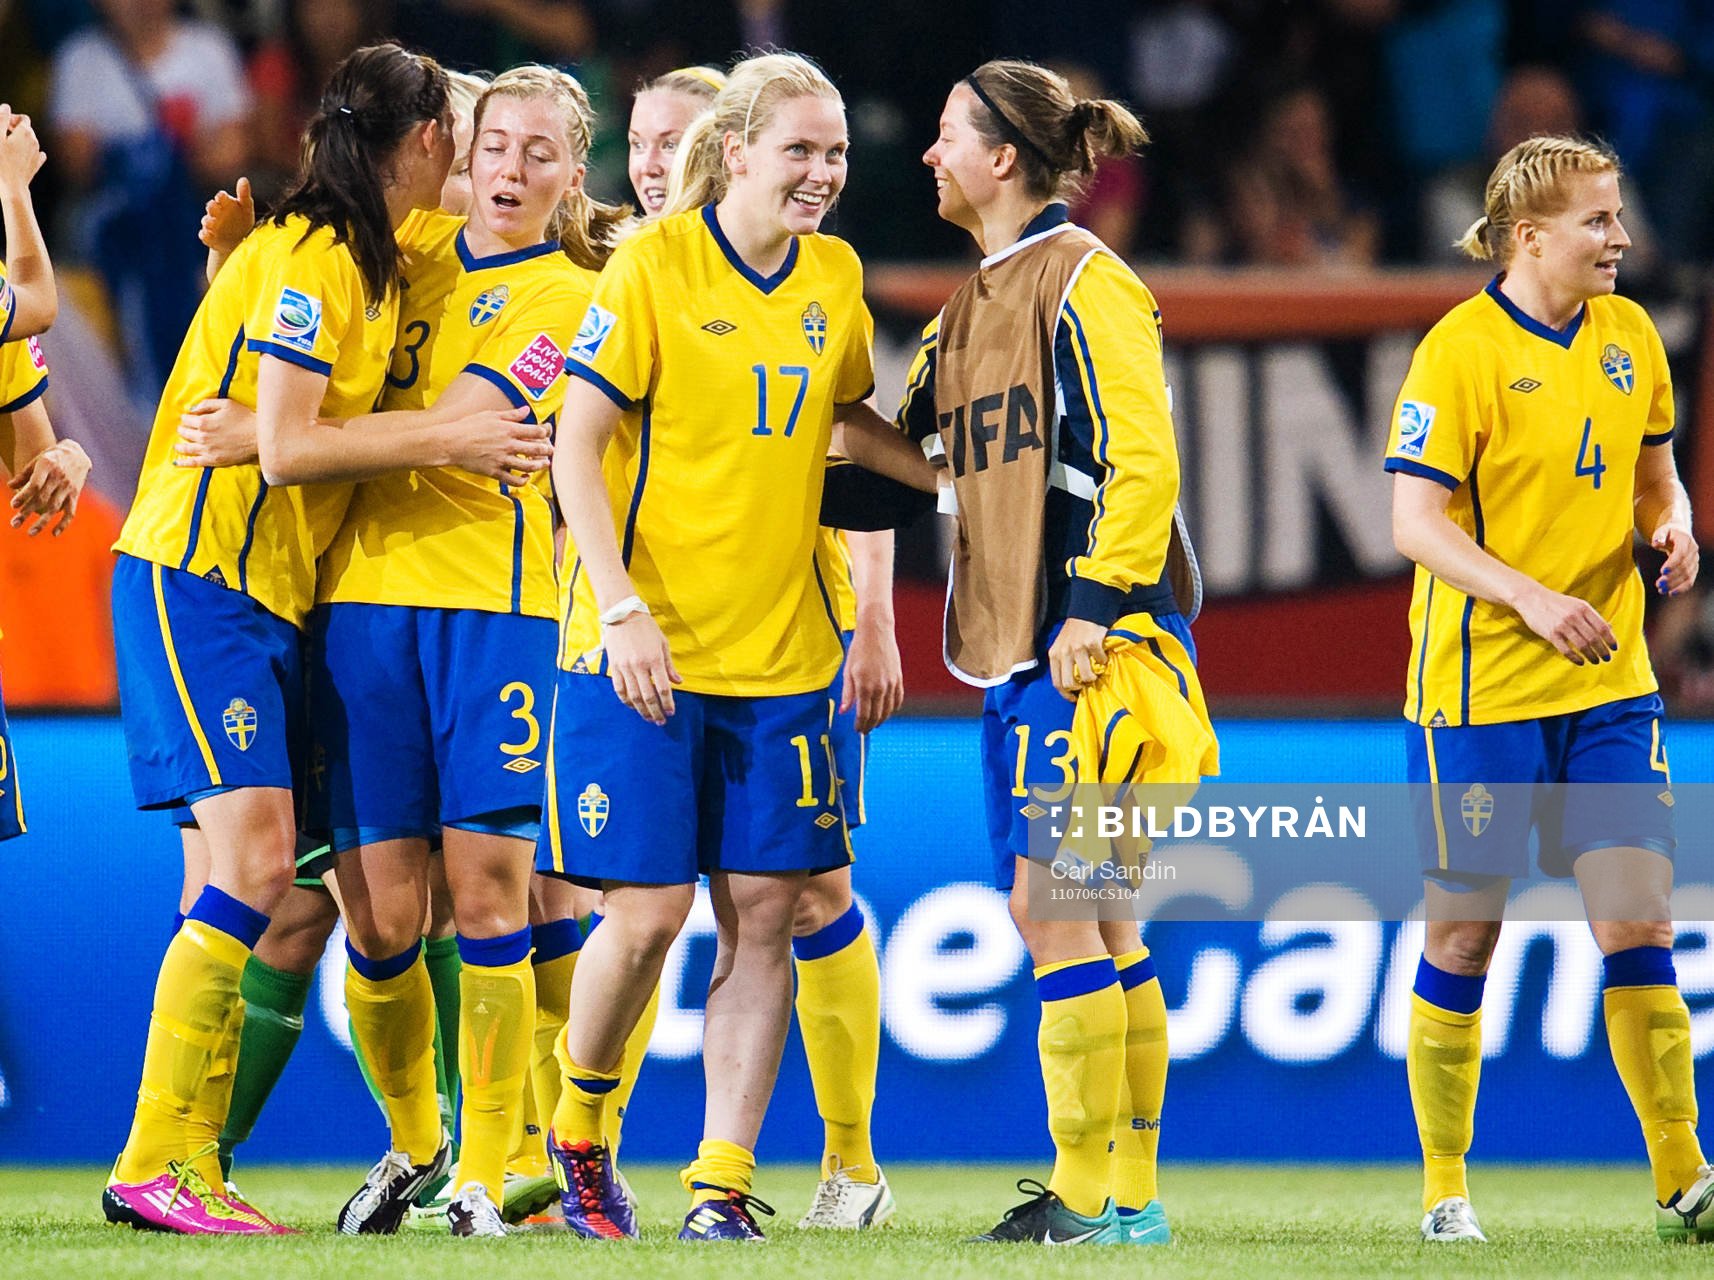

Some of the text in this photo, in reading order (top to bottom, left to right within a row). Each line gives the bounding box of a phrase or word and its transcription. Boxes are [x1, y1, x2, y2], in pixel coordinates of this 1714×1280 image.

[515, 359, 553, 386] GOALS
[525, 350, 556, 376] YOUR
[532, 341, 560, 362] LIVE
[752, 364, 809, 437] 17
[1575, 417, 1607, 489] 4
[499, 681, 541, 756] 3
[1011, 724, 1078, 802] 13
